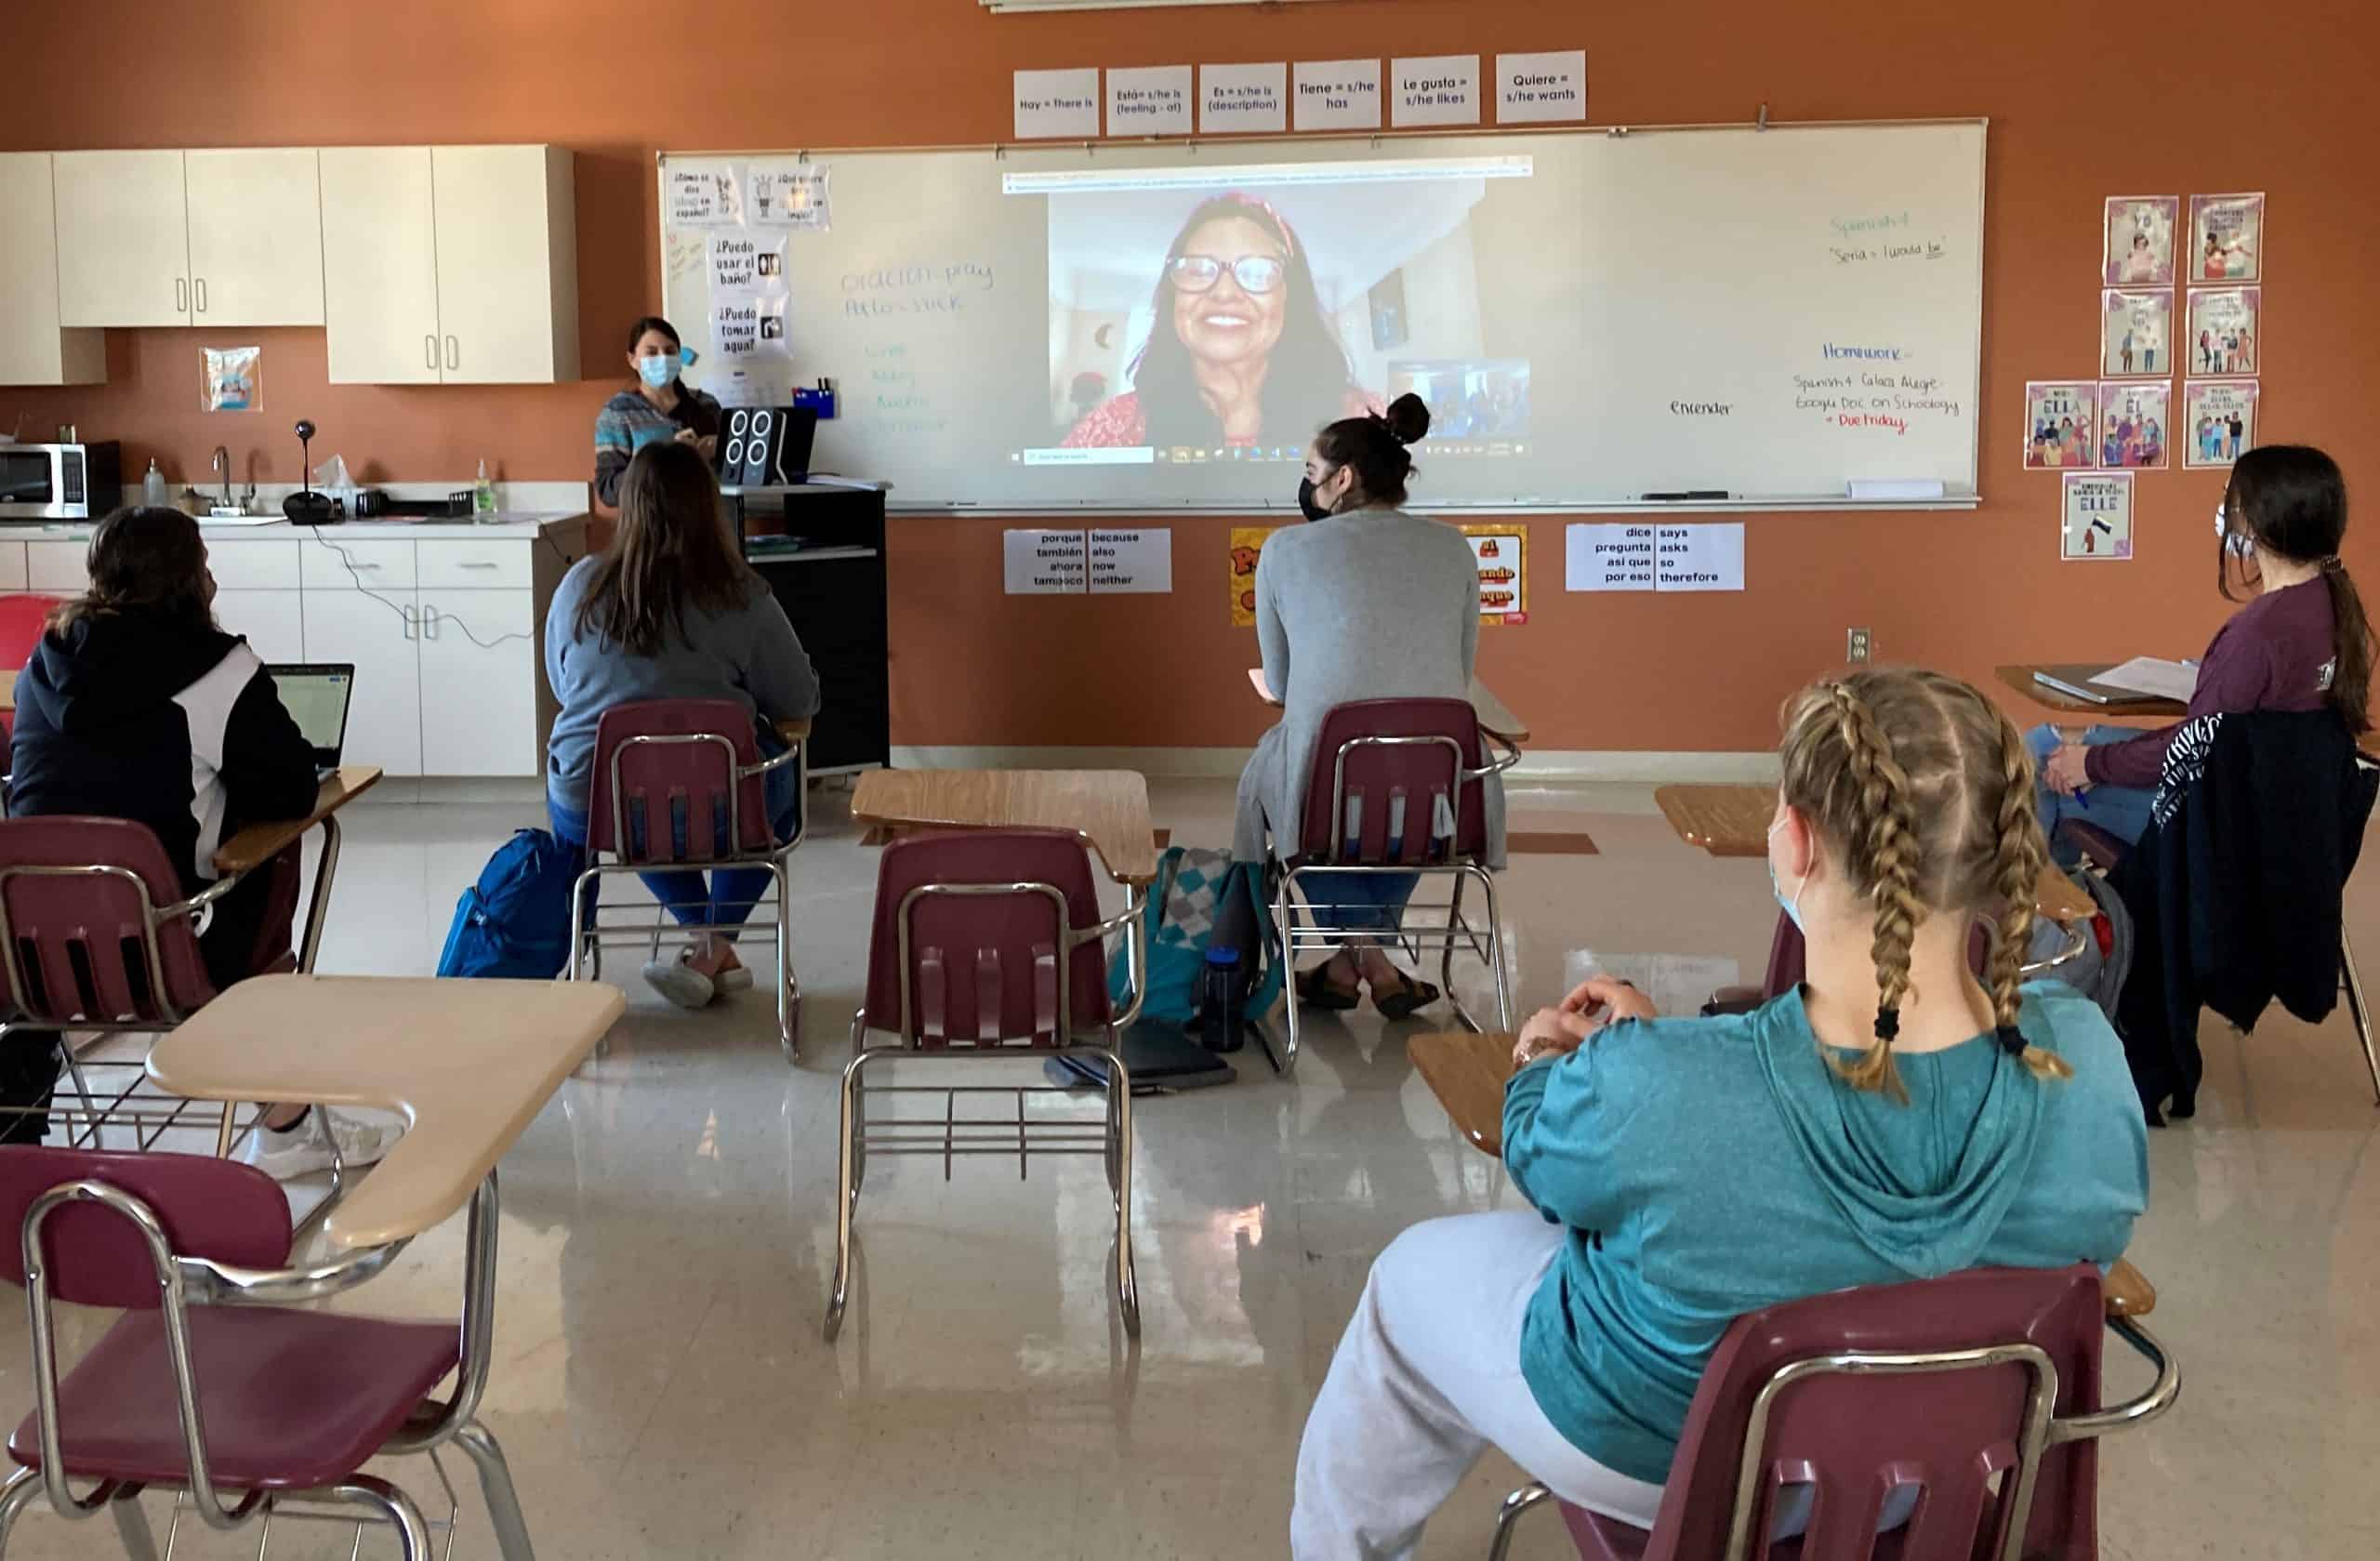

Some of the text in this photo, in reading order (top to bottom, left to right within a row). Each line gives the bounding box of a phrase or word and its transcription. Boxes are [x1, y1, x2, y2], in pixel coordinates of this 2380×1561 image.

[1404, 79, 1418, 90] Le
[1421, 78, 1457, 92] gusta
[1514, 74, 1556, 86] Quiere
[1213, 87, 1224, 97] Es
[1237, 86, 1260, 98] s/he
[1263, 86, 1272, 96] is
[1300, 83, 1331, 94] Tiene
[1347, 81, 1375, 93] s/he
[1147, 90, 1170, 101] s/he
[1173, 89, 1182, 99] is
[1406, 93, 1465, 106] s/he likes
[1506, 89, 1576, 103] s/he wants
[1020, 99, 1041, 112] Hay
[1085, 97, 1093, 108] is
[1117, 103, 1157, 115] (feeling
[1168, 102, 1182, 113] at)
[1208, 99, 1277, 112] (description)
[1326, 98, 1348, 109] has
[716, 239, 754, 253] ¿Puedo
[717, 256, 755, 270] usar el
[720, 271, 752, 285] baño?
[720, 308, 757, 321] ¿Puedo
[721, 325, 756, 337] tomar
[723, 338, 756, 354] agua?
[2043, 400, 2082, 414] ELLA
[2081, 497, 2118, 511] ELLE
[1091, 533, 1139, 543] because
[1626, 527, 1651, 537] dice
[1659, 529, 1688, 539] says
[1041, 534, 1082, 544] porque
[1092, 546, 1115, 557] also
[1595, 543, 1651, 554] pregunta
[1659, 543, 1688, 552] asks
[1092, 562, 1116, 572] now
[1628, 559, 1651, 568] que
[1092, 575, 1133, 586] neither
[1606, 573, 1626, 583] por
[1659, 572, 1719, 582] therefore
